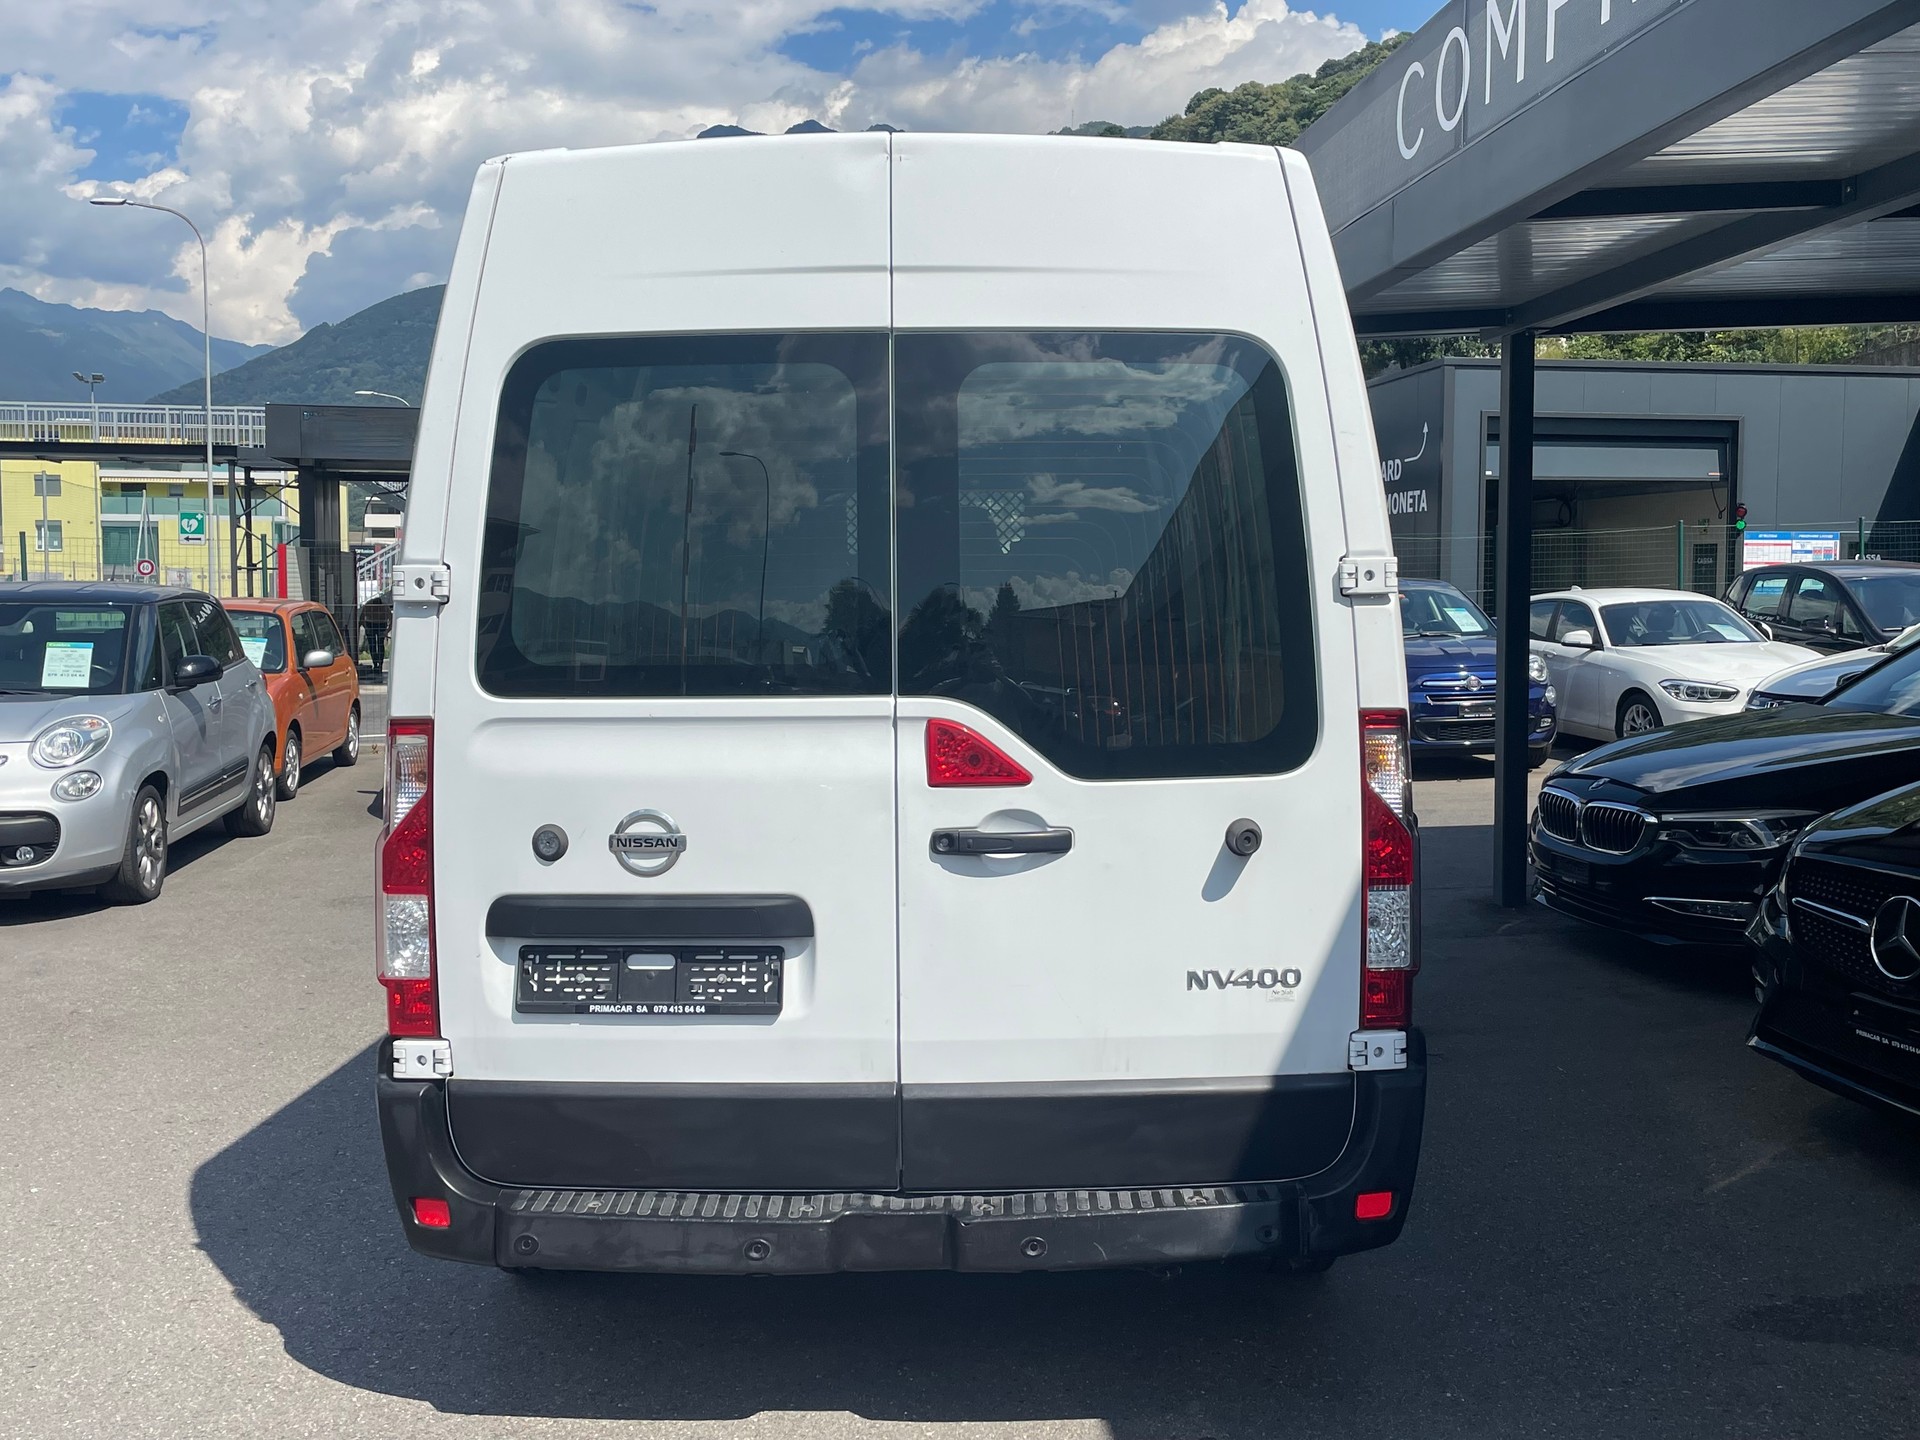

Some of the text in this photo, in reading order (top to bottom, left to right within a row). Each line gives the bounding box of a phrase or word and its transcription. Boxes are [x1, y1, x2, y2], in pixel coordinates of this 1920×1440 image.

[616, 838, 678, 848] NISSAN
[1186, 968, 1302, 991] NV400
[589, 1004, 706, 1013] PRIMACAR SA 079 413 64 64
